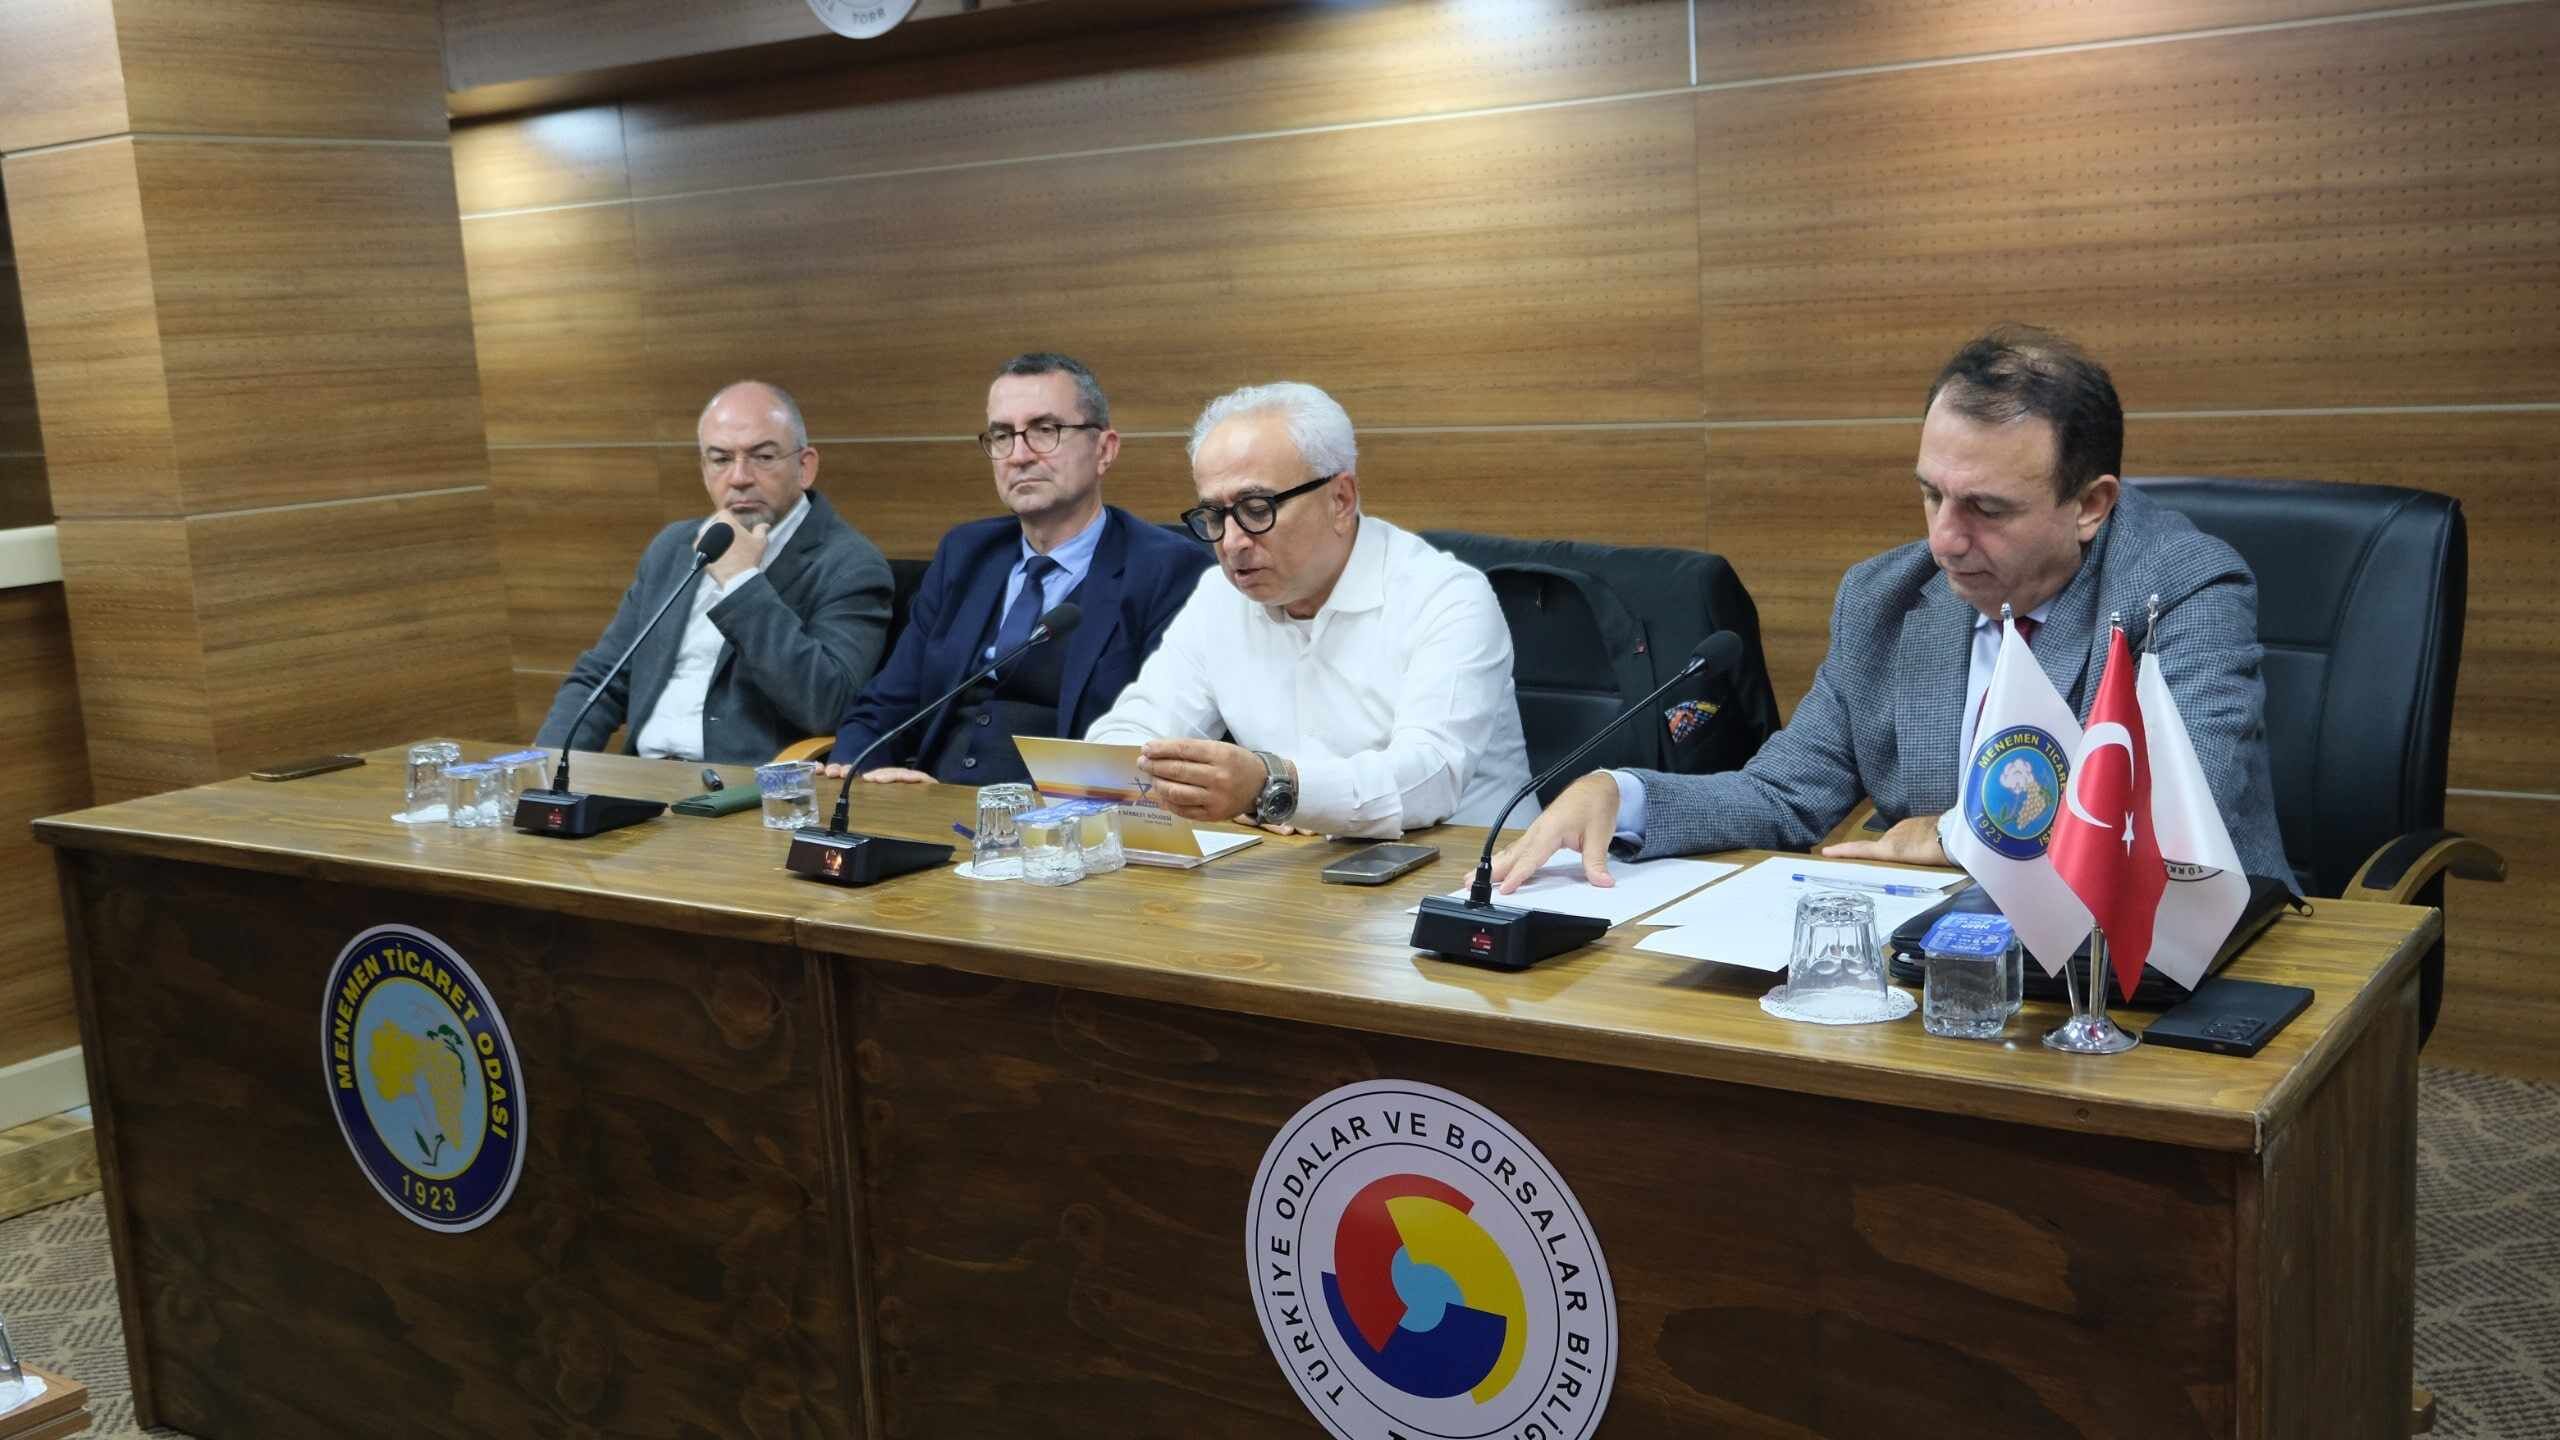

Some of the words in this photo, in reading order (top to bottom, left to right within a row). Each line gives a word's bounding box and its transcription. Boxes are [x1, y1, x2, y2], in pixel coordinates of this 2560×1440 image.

[1978, 733, 2040, 769] MENEMEN
[1974, 813, 2002, 844] 1923
[334, 954, 382, 1089] MENEMEN
[382, 943, 479, 1021] TİCARET
[476, 1031, 510, 1140] ODASI
[1383, 1110, 1428, 1137] VE
[400, 1174, 457, 1213] 1923
[1275, 1115, 1371, 1220] ODALAR
[1445, 1122, 1588, 1312] BORSALAR
[1271, 1235, 1345, 1407] TÜRKİYE
